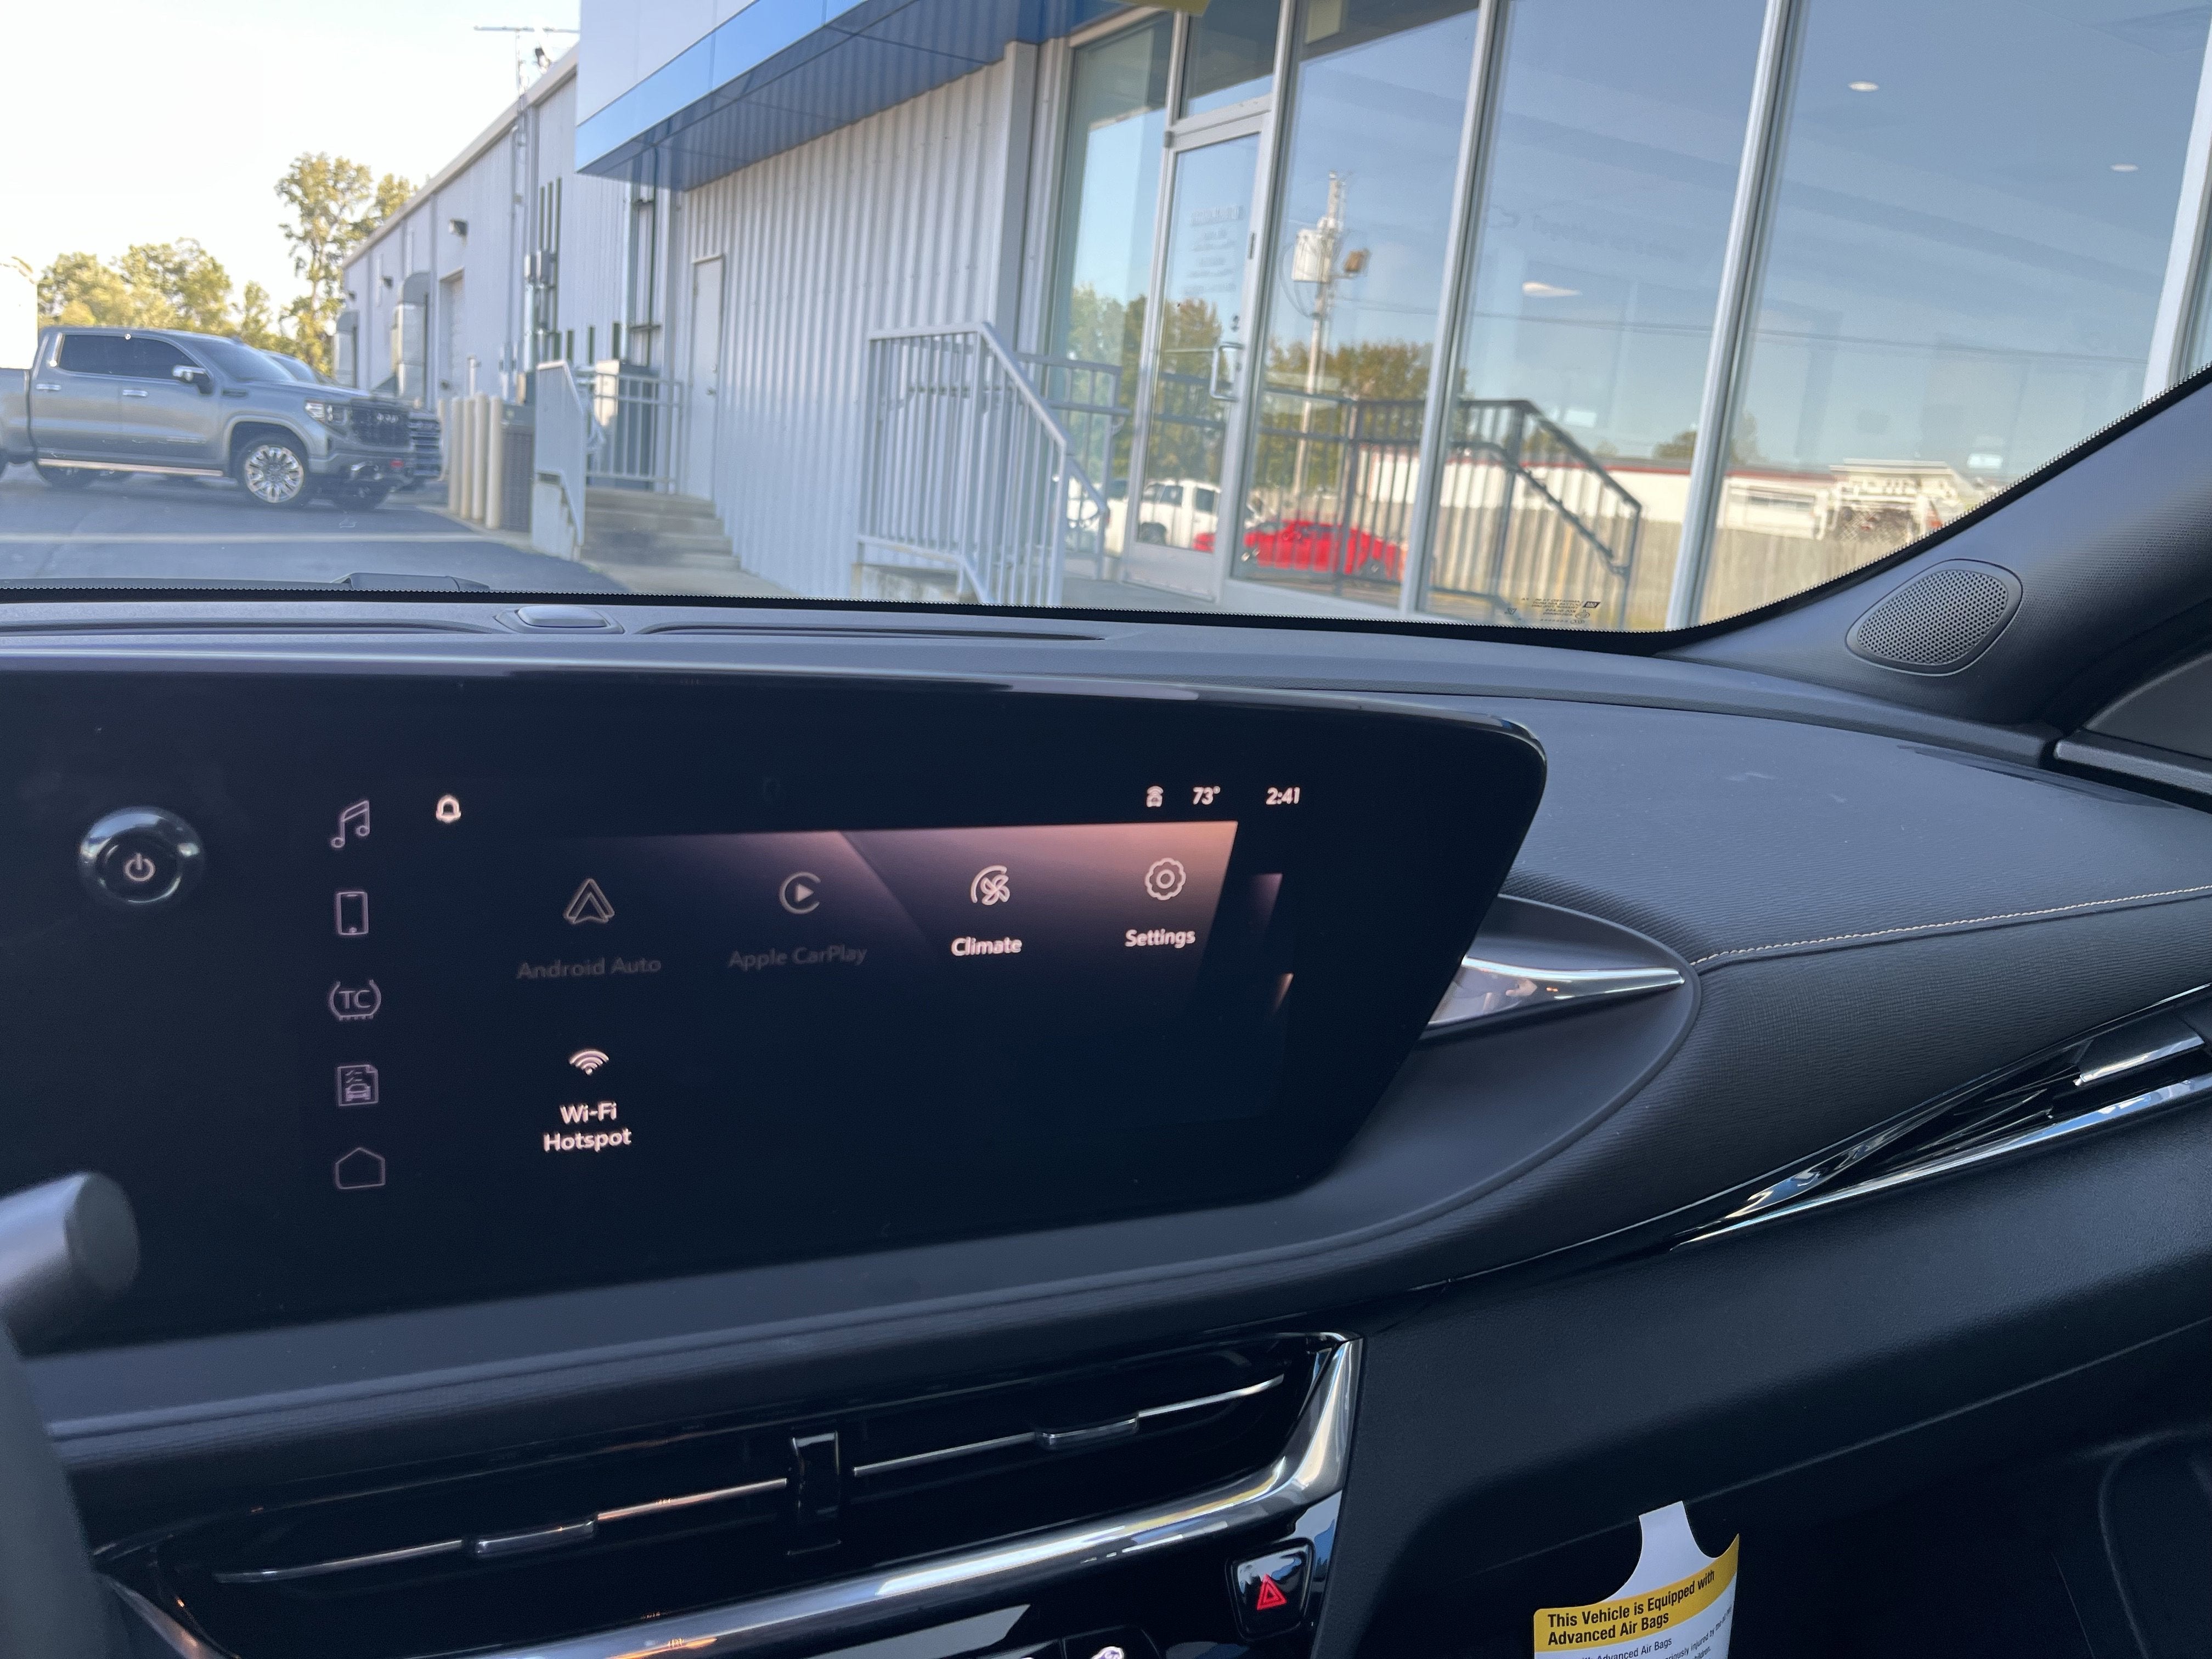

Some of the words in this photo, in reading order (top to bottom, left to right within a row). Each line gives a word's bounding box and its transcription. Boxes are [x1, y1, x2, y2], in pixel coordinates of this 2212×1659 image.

[1193, 786, 1221, 805] 73°
[1266, 787, 1300, 805] 2:41
[951, 936, 1023, 956] Climate
[1124, 928, 1195, 949] Settings
[516, 957, 605, 979] Android
[610, 957, 662, 974] Auto
[727, 947, 787, 972] Apple
[792, 944, 868, 966] CarPlay
[339, 990, 371, 1009] TC
[560, 1101, 617, 1124] Wi-Fi
[543, 1128, 631, 1152] Hotspot
[1548, 1613, 1577, 1627] This
[1582, 1606, 1630, 1624] Vehicle
[1634, 1602, 1644, 1616] is
[1647, 1581, 1695, 1611] Equipped
[1697, 1570, 1714, 1590] with
[1548, 1624, 1616, 1646] Advanced
[1620, 1621, 1637, 1637] Air
[1641, 1612, 1669, 1631] Bags
[1641, 1644, 1651, 1655] Air
[1654, 1638, 1672, 1651] Bags
[1665, 1647, 1689, 1659] riously
